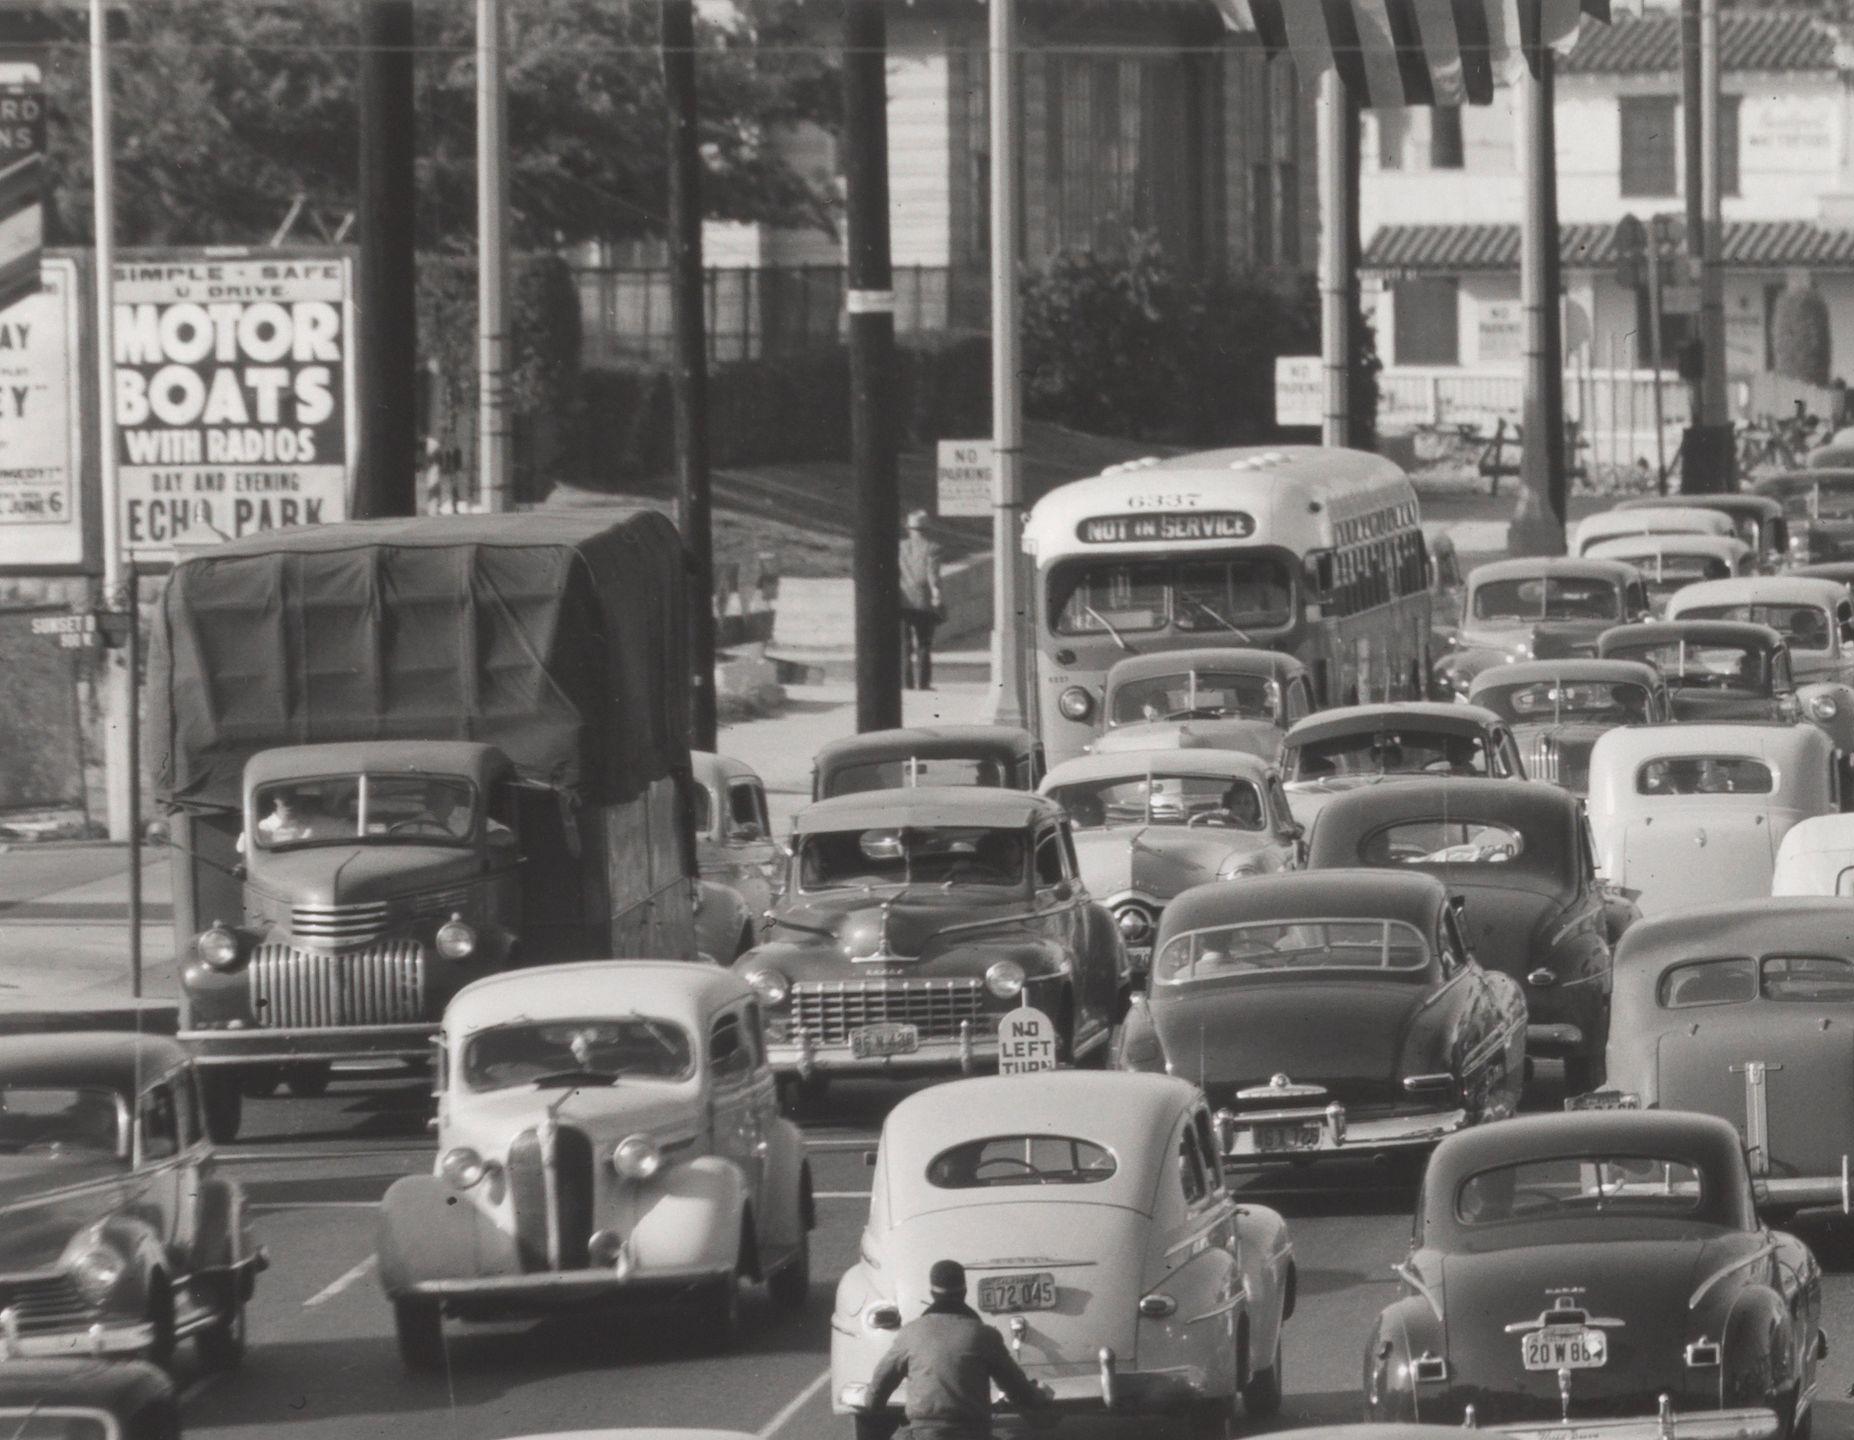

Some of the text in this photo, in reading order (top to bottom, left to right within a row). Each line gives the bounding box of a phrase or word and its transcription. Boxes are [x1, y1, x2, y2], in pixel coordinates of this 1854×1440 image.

[114, 264, 340, 281] SIMPLE SAFE
[207, 284, 286, 298] DRIVE
[114, 301, 342, 365] MOTOR
[116, 364, 335, 426] BOATS
[125, 427, 317, 465] WITH RADIOS
[954, 448, 978, 464] NO
[152, 471, 301, 493] DAY AND EVENING
[1087, 516, 1247, 541] NOT IN SERVICE
[1011, 1020, 1040, 1038] NO
[1001, 1040, 1051, 1059] LEFT
[996, 1286, 1016, 1307] 72
[1020, 1281, 1052, 1306] 045
[1530, 1345, 1550, 1364] 20
[1555, 1344, 1566, 1363] W
